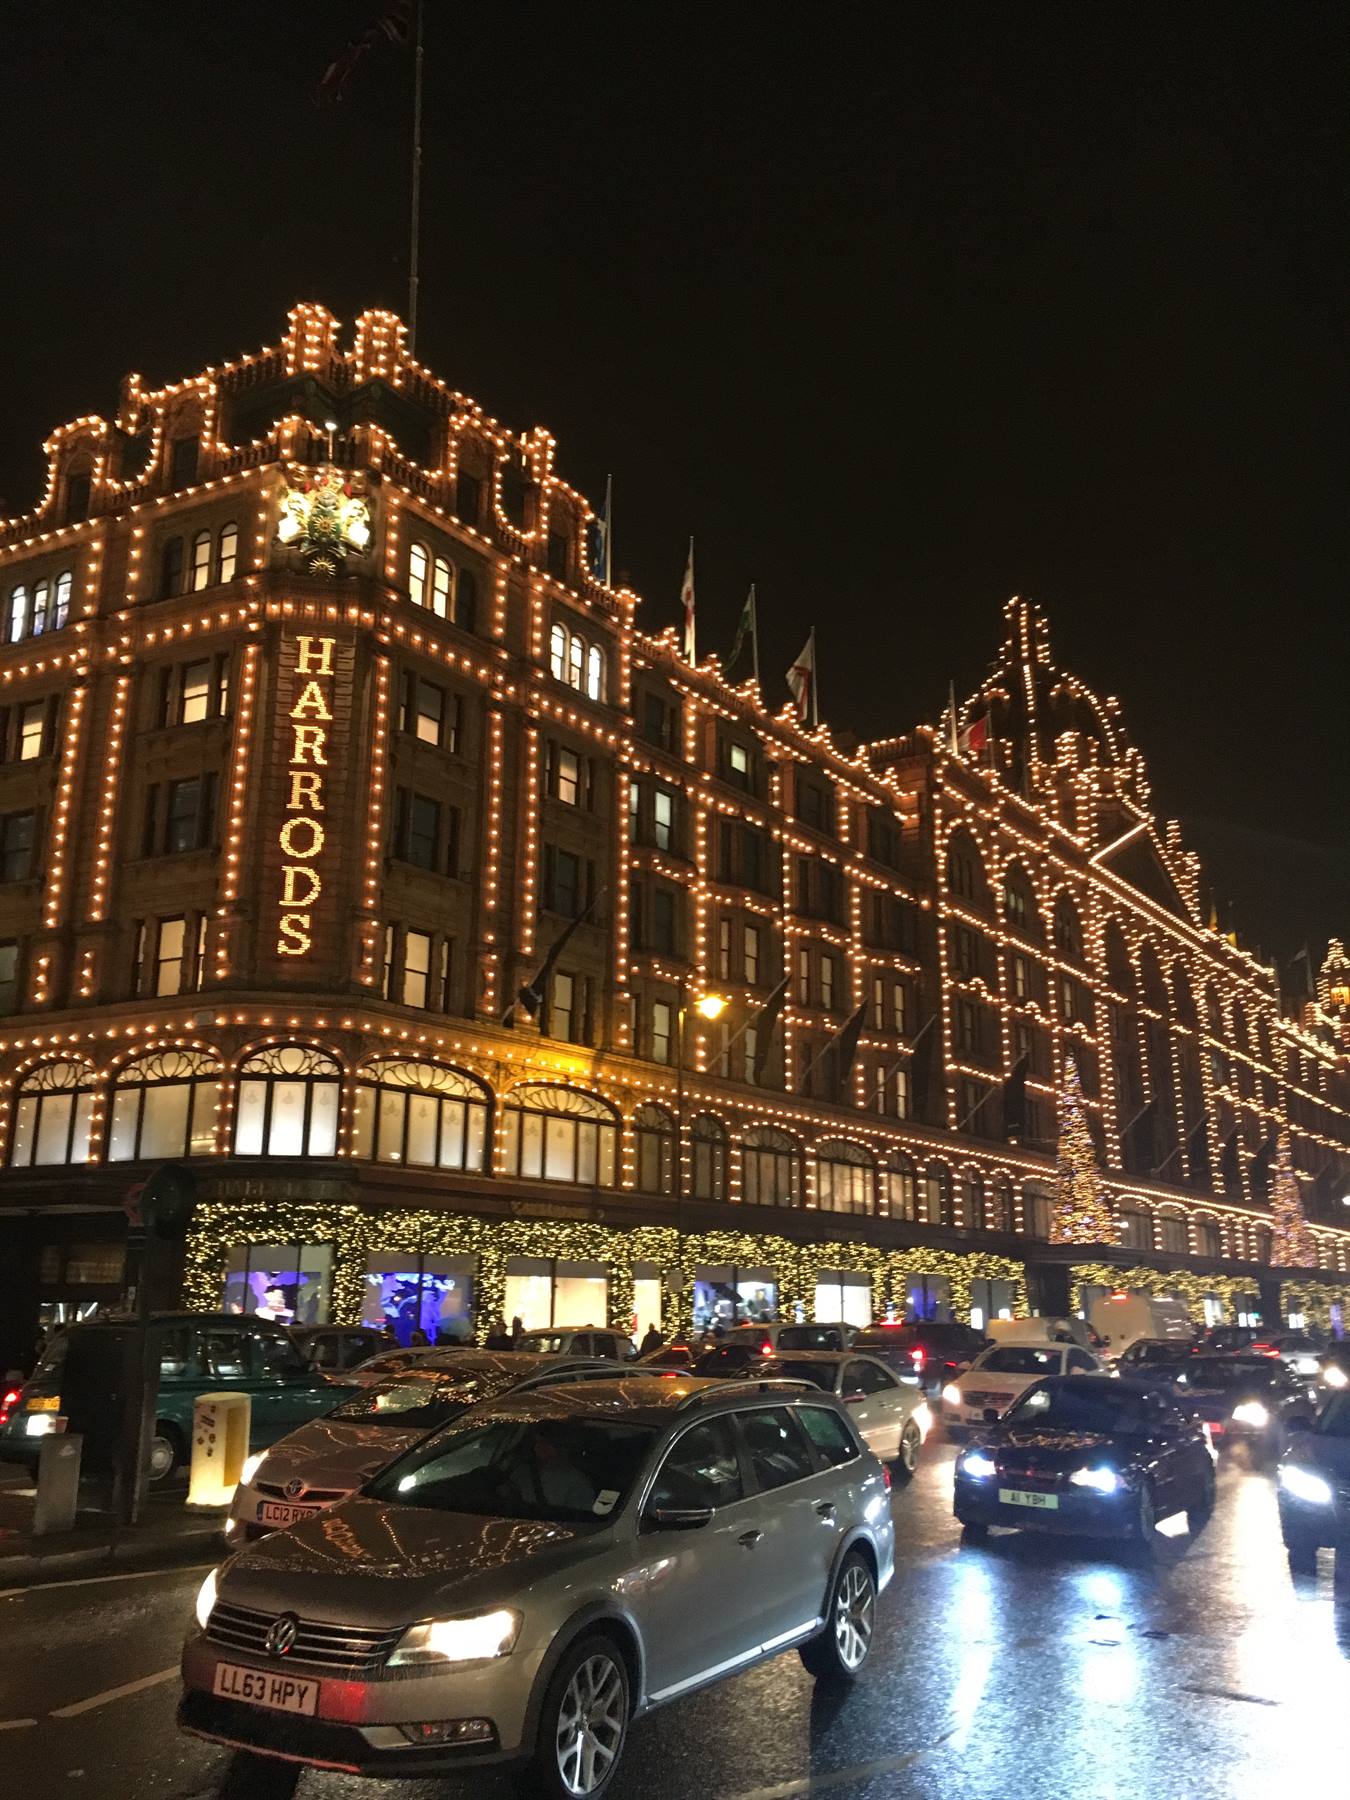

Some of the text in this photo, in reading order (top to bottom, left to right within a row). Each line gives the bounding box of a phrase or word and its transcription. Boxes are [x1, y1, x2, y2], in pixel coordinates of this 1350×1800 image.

[278, 635, 336, 956] HARRODS
[265, 1505, 290, 1522] LC12
[220, 1668, 309, 1709] LL63 HPY
